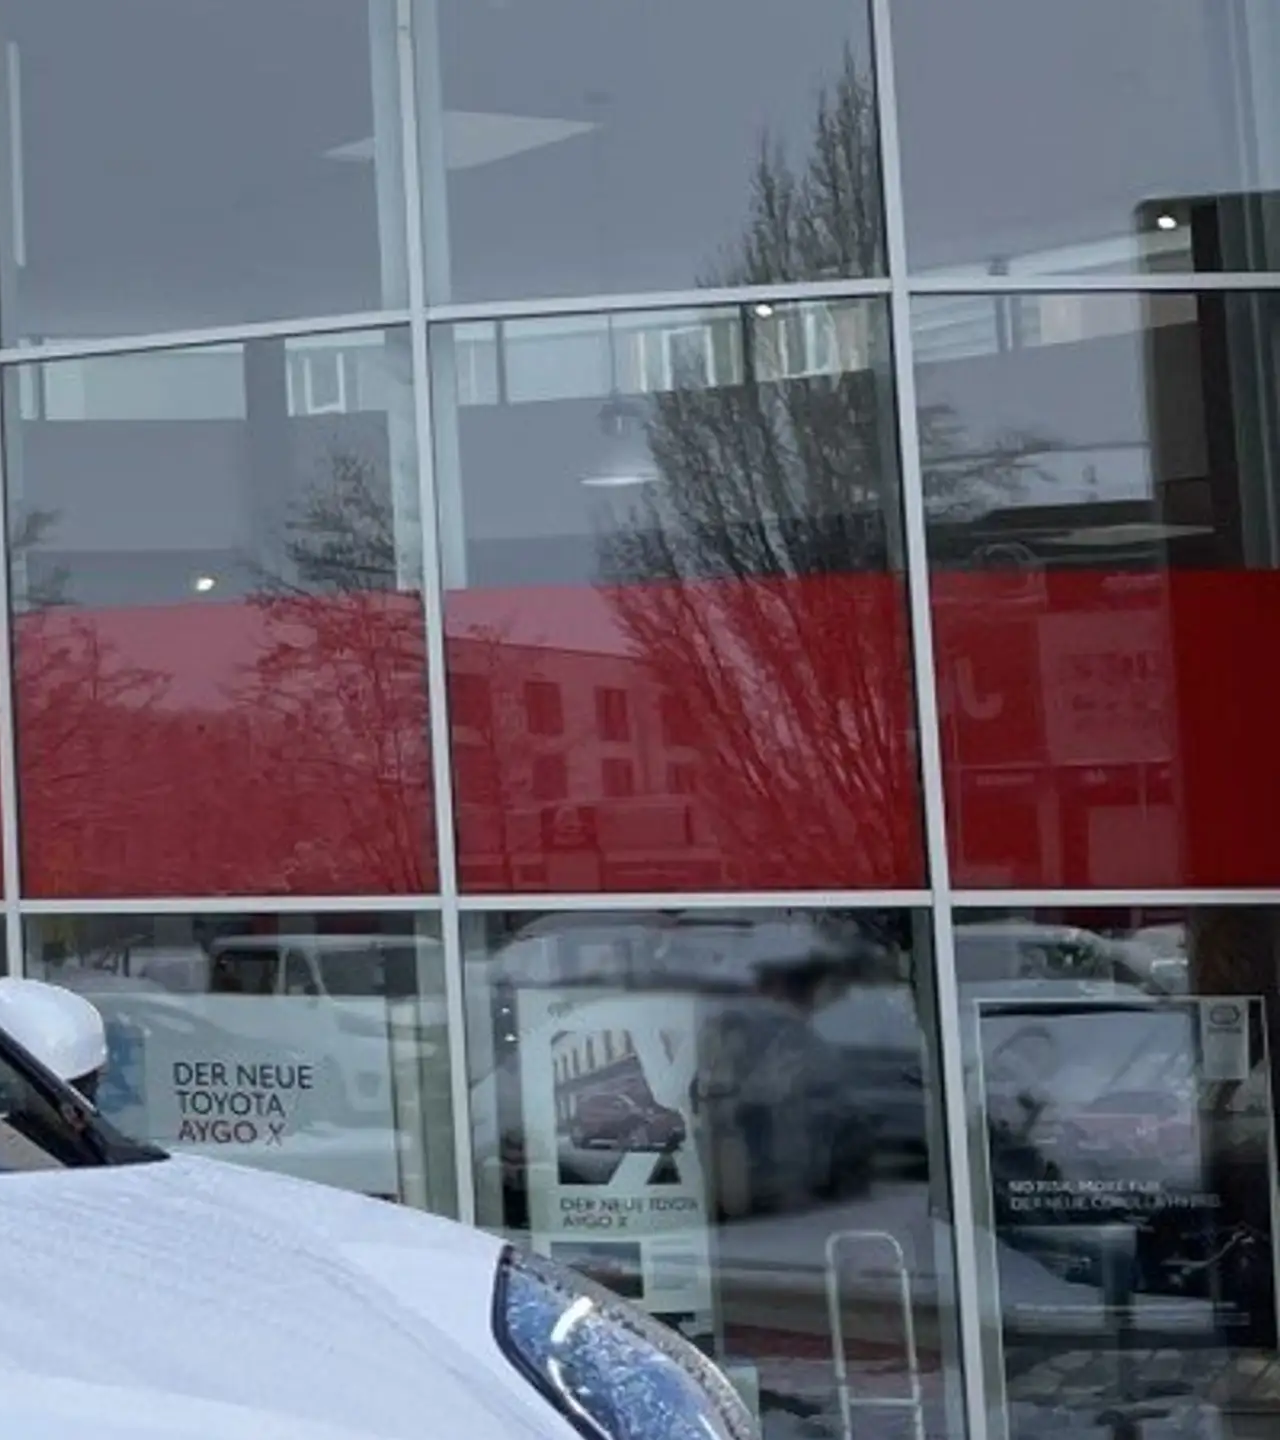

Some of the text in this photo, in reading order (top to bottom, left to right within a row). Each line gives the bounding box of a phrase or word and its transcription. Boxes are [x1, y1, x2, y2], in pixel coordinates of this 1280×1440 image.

[173, 1062, 313, 1089] DER NEUE
[175, 1090, 286, 1117] TOYOTA
[178, 1120, 286, 1147] AYGO X
